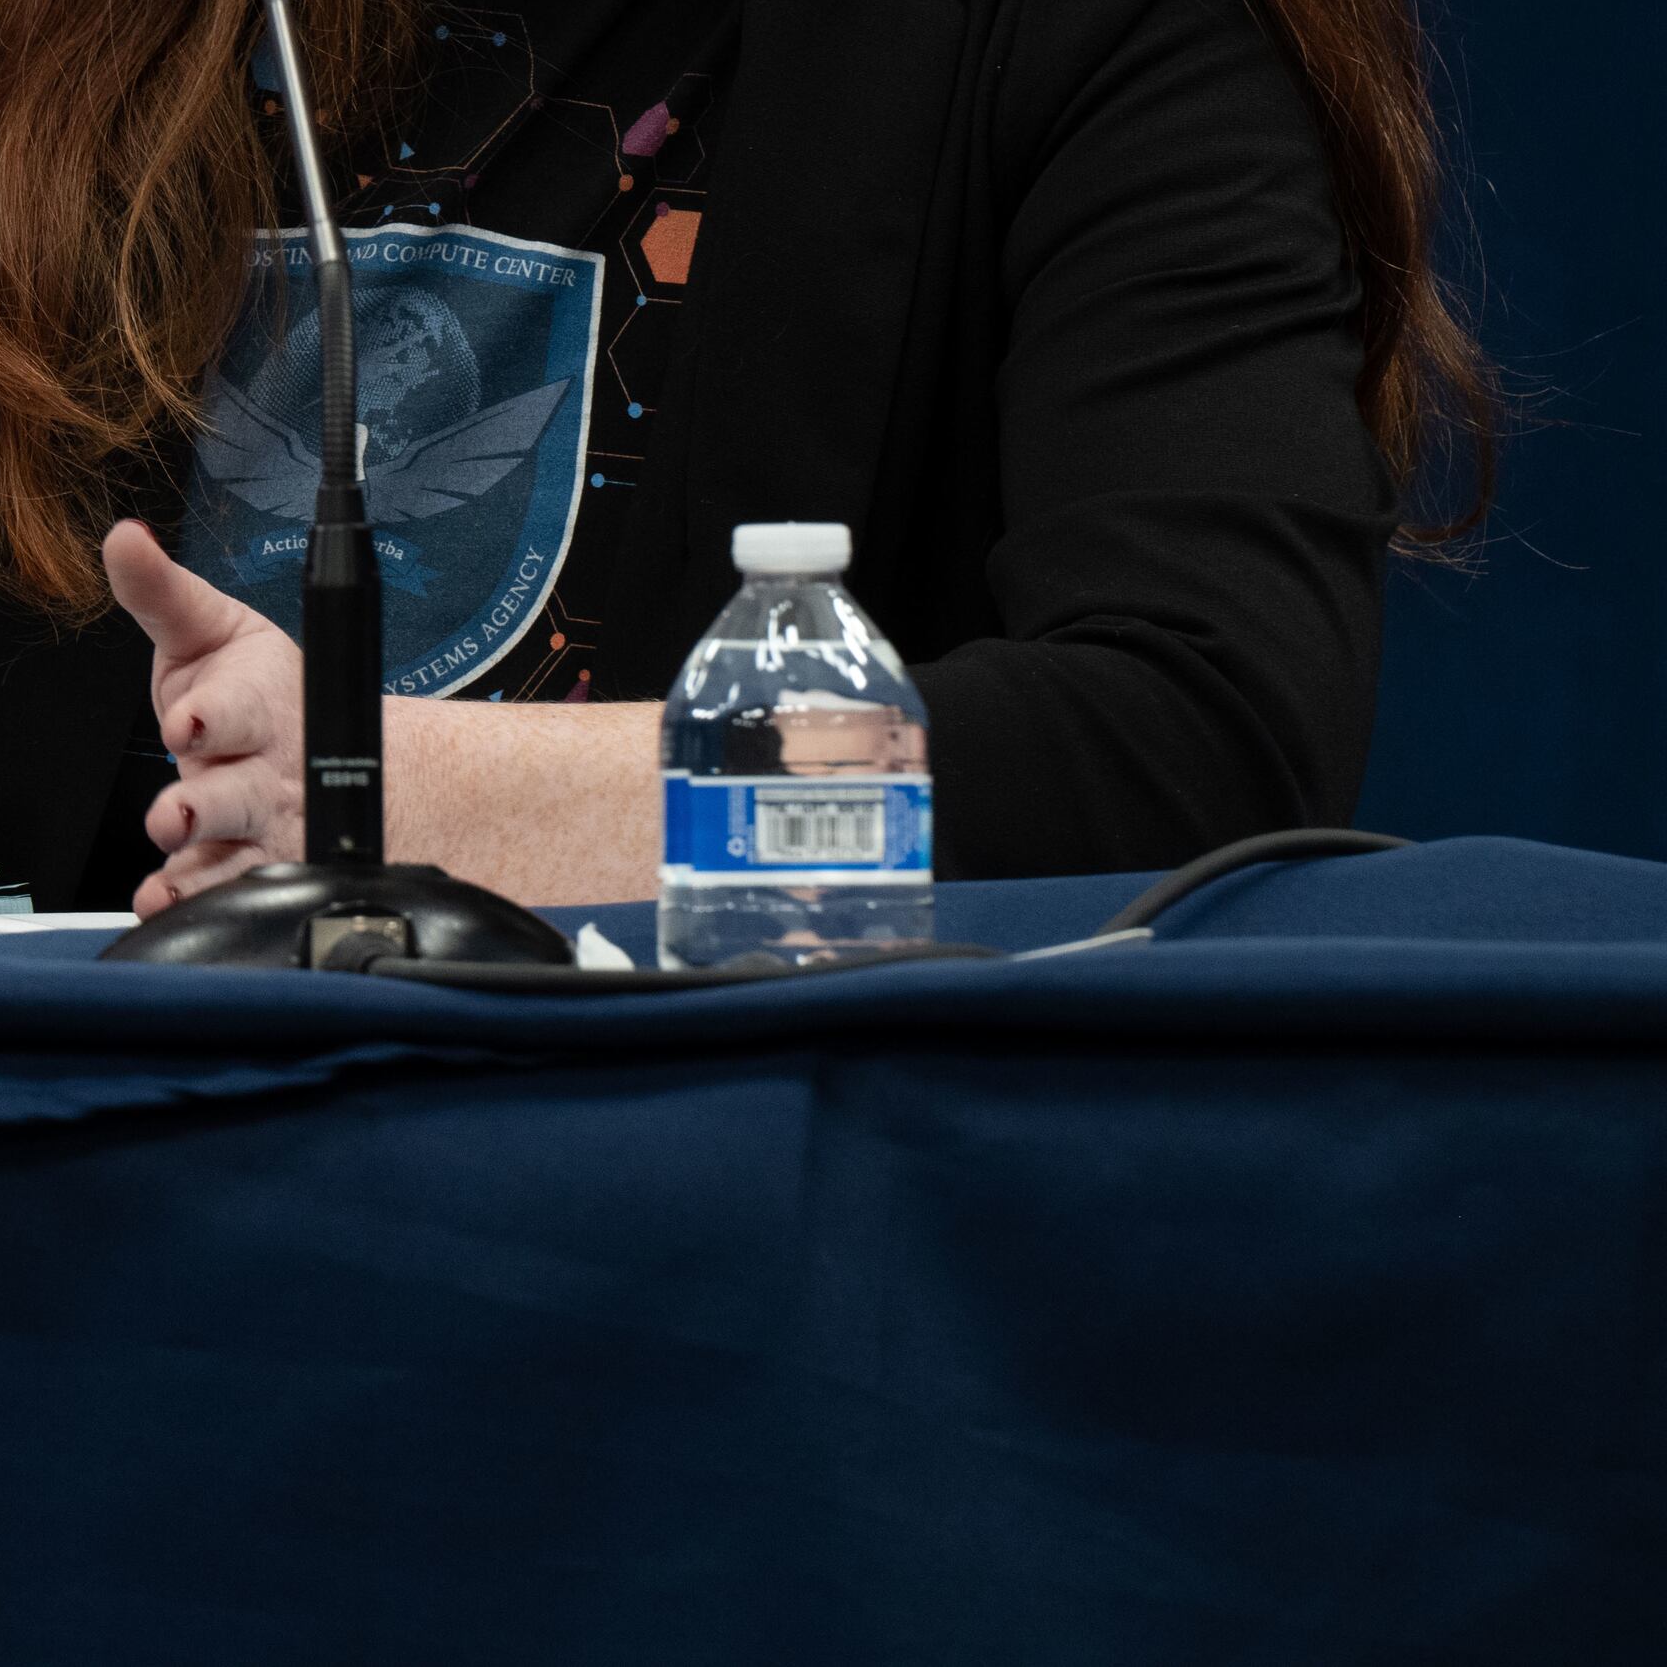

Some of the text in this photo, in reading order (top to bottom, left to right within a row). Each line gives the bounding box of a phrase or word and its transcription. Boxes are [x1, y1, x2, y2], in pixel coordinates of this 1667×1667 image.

[383, 242, 490, 270] COMPUTE
[494, 256, 575, 287] CENTER
[384, 545, 545, 696] YSTEMS AGENCY
